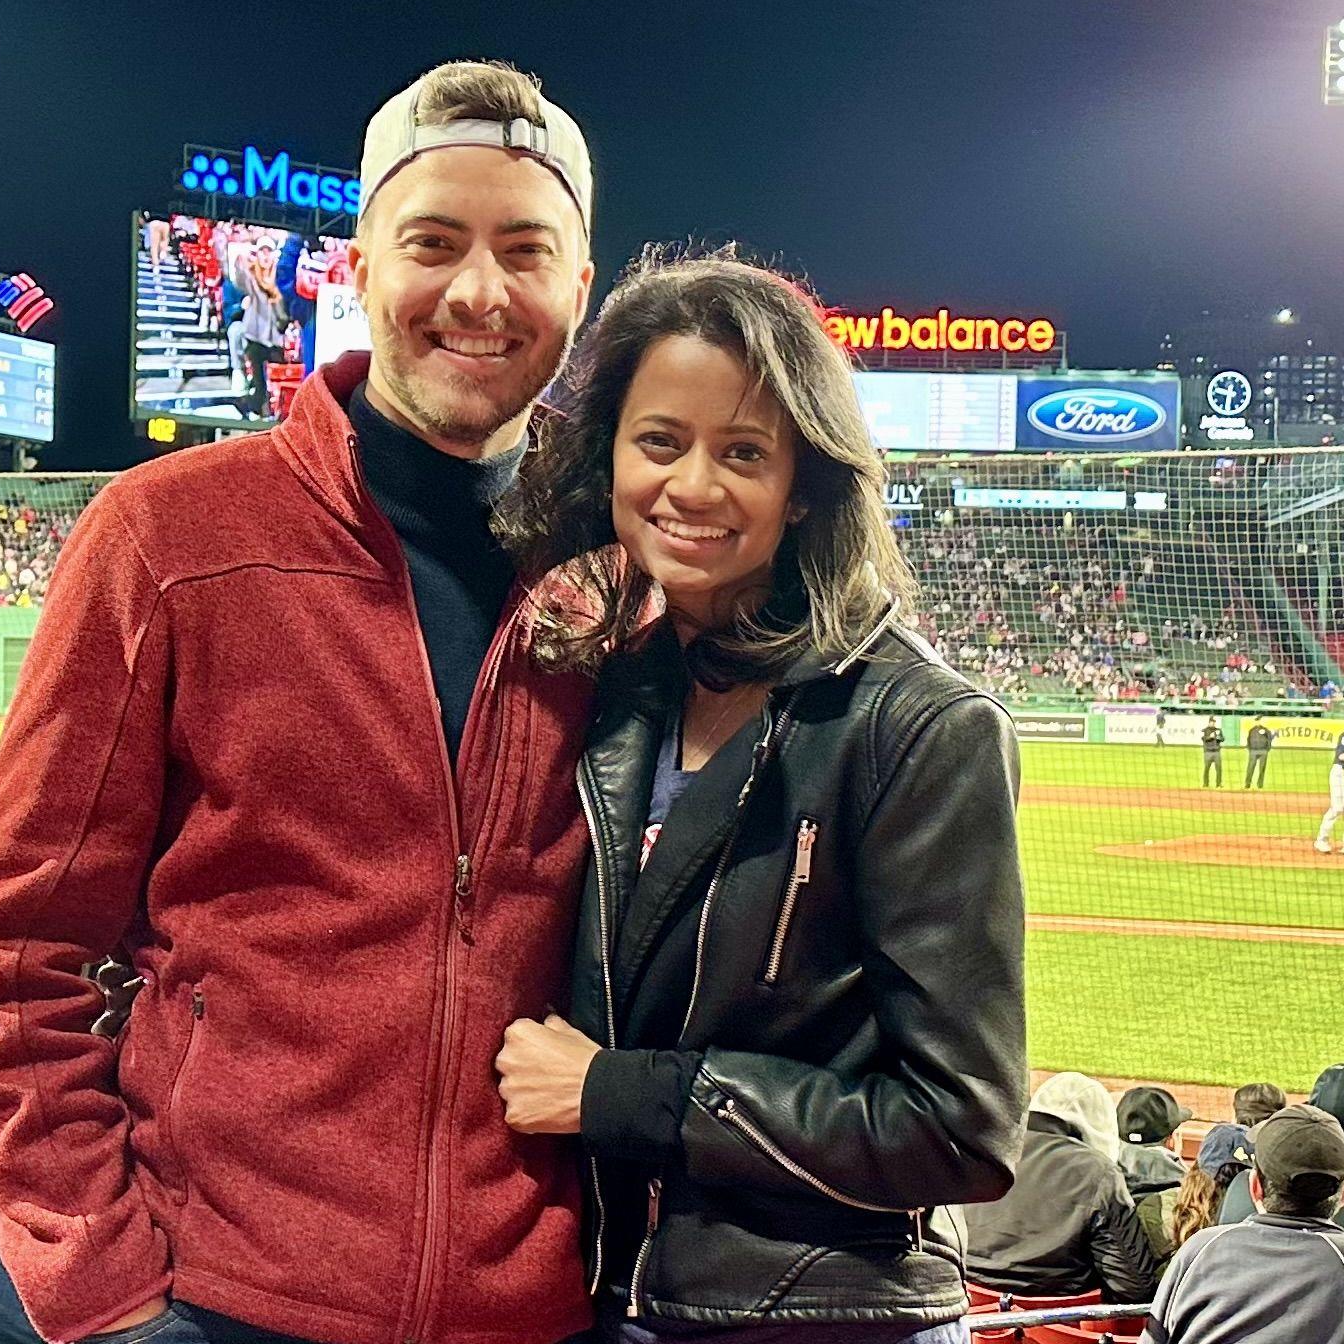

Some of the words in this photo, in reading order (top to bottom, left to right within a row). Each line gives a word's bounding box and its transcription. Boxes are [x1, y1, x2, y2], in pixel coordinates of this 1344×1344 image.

[1056, 396, 1137, 434] Ford
[884, 484, 924, 504] ULY
[1314, 728, 1334, 744] TEA
